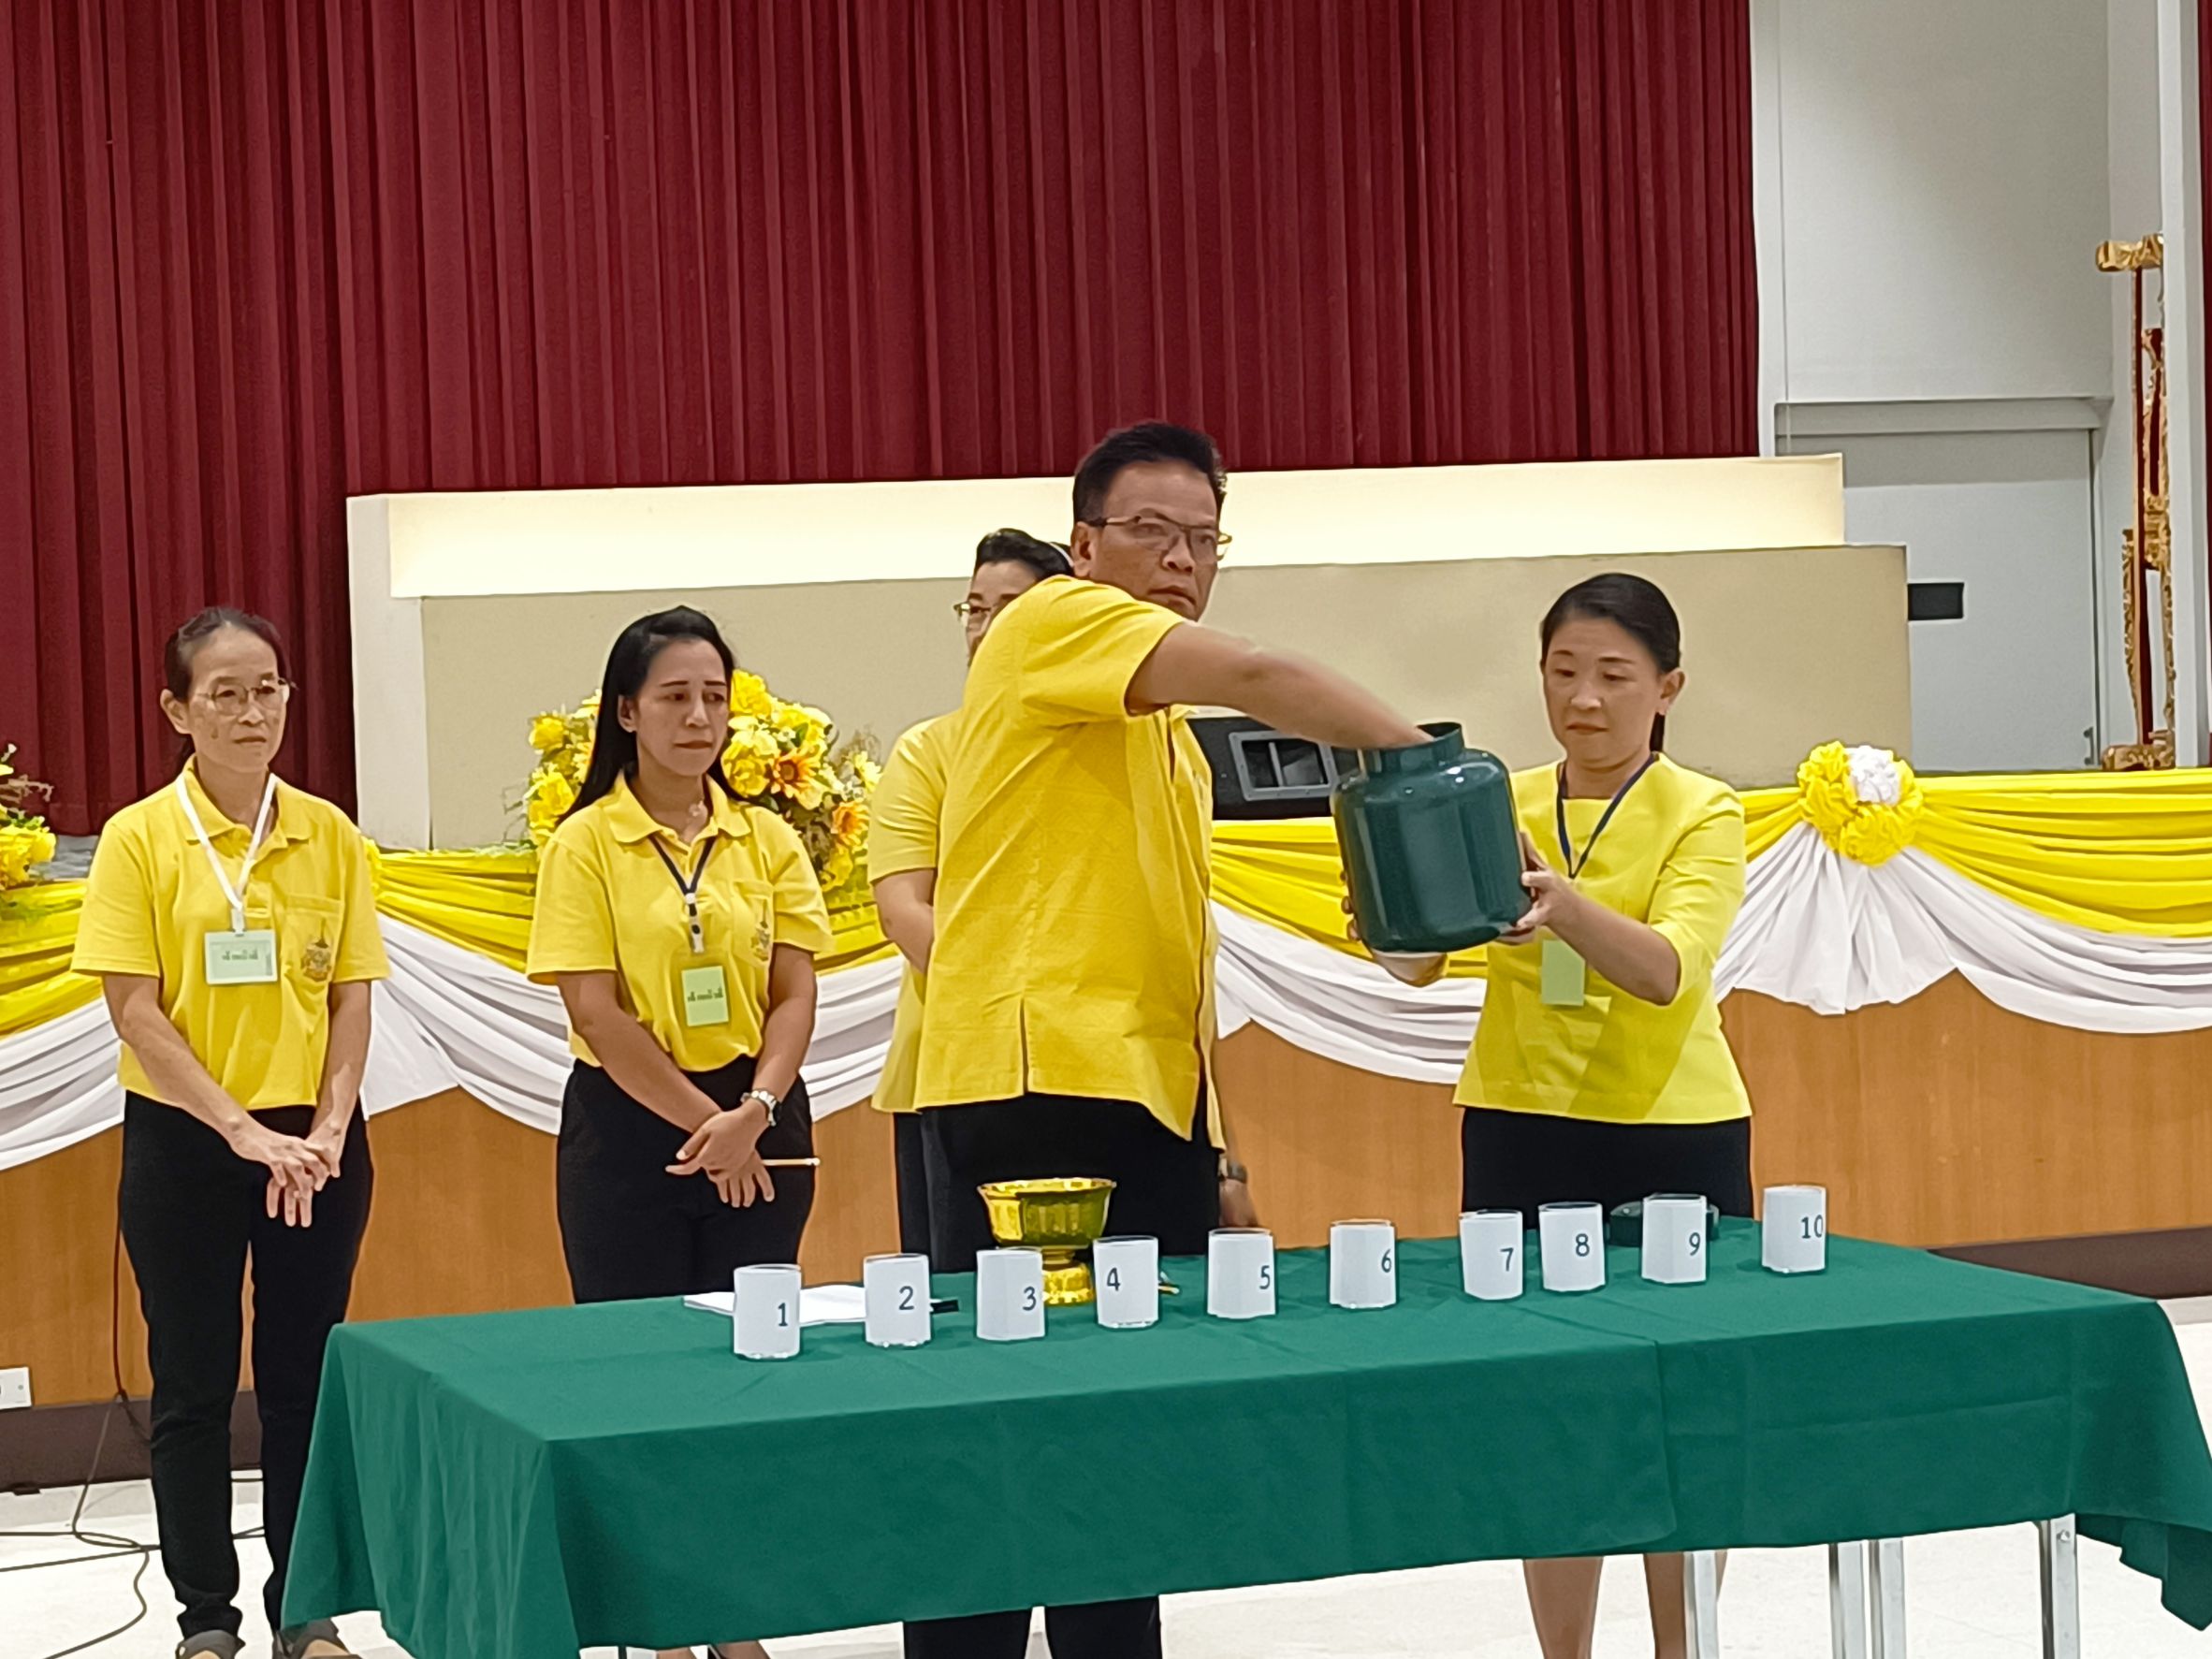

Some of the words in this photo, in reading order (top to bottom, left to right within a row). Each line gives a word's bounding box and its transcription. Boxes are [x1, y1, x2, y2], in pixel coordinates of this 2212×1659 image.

[1801, 1215, 1824, 1239] 10
[1575, 1233, 1590, 1258] 8
[1689, 1231, 1701, 1256] 9
[1381, 1249, 1392, 1273] 6
[1500, 1247, 1514, 1272] 7
[1106, 1267, 1121, 1291] 4
[1259, 1265, 1271, 1290] 5
[898, 1286, 914, 1311] 2
[1023, 1286, 1037, 1311] 3
[777, 1302, 789, 1327] 1
